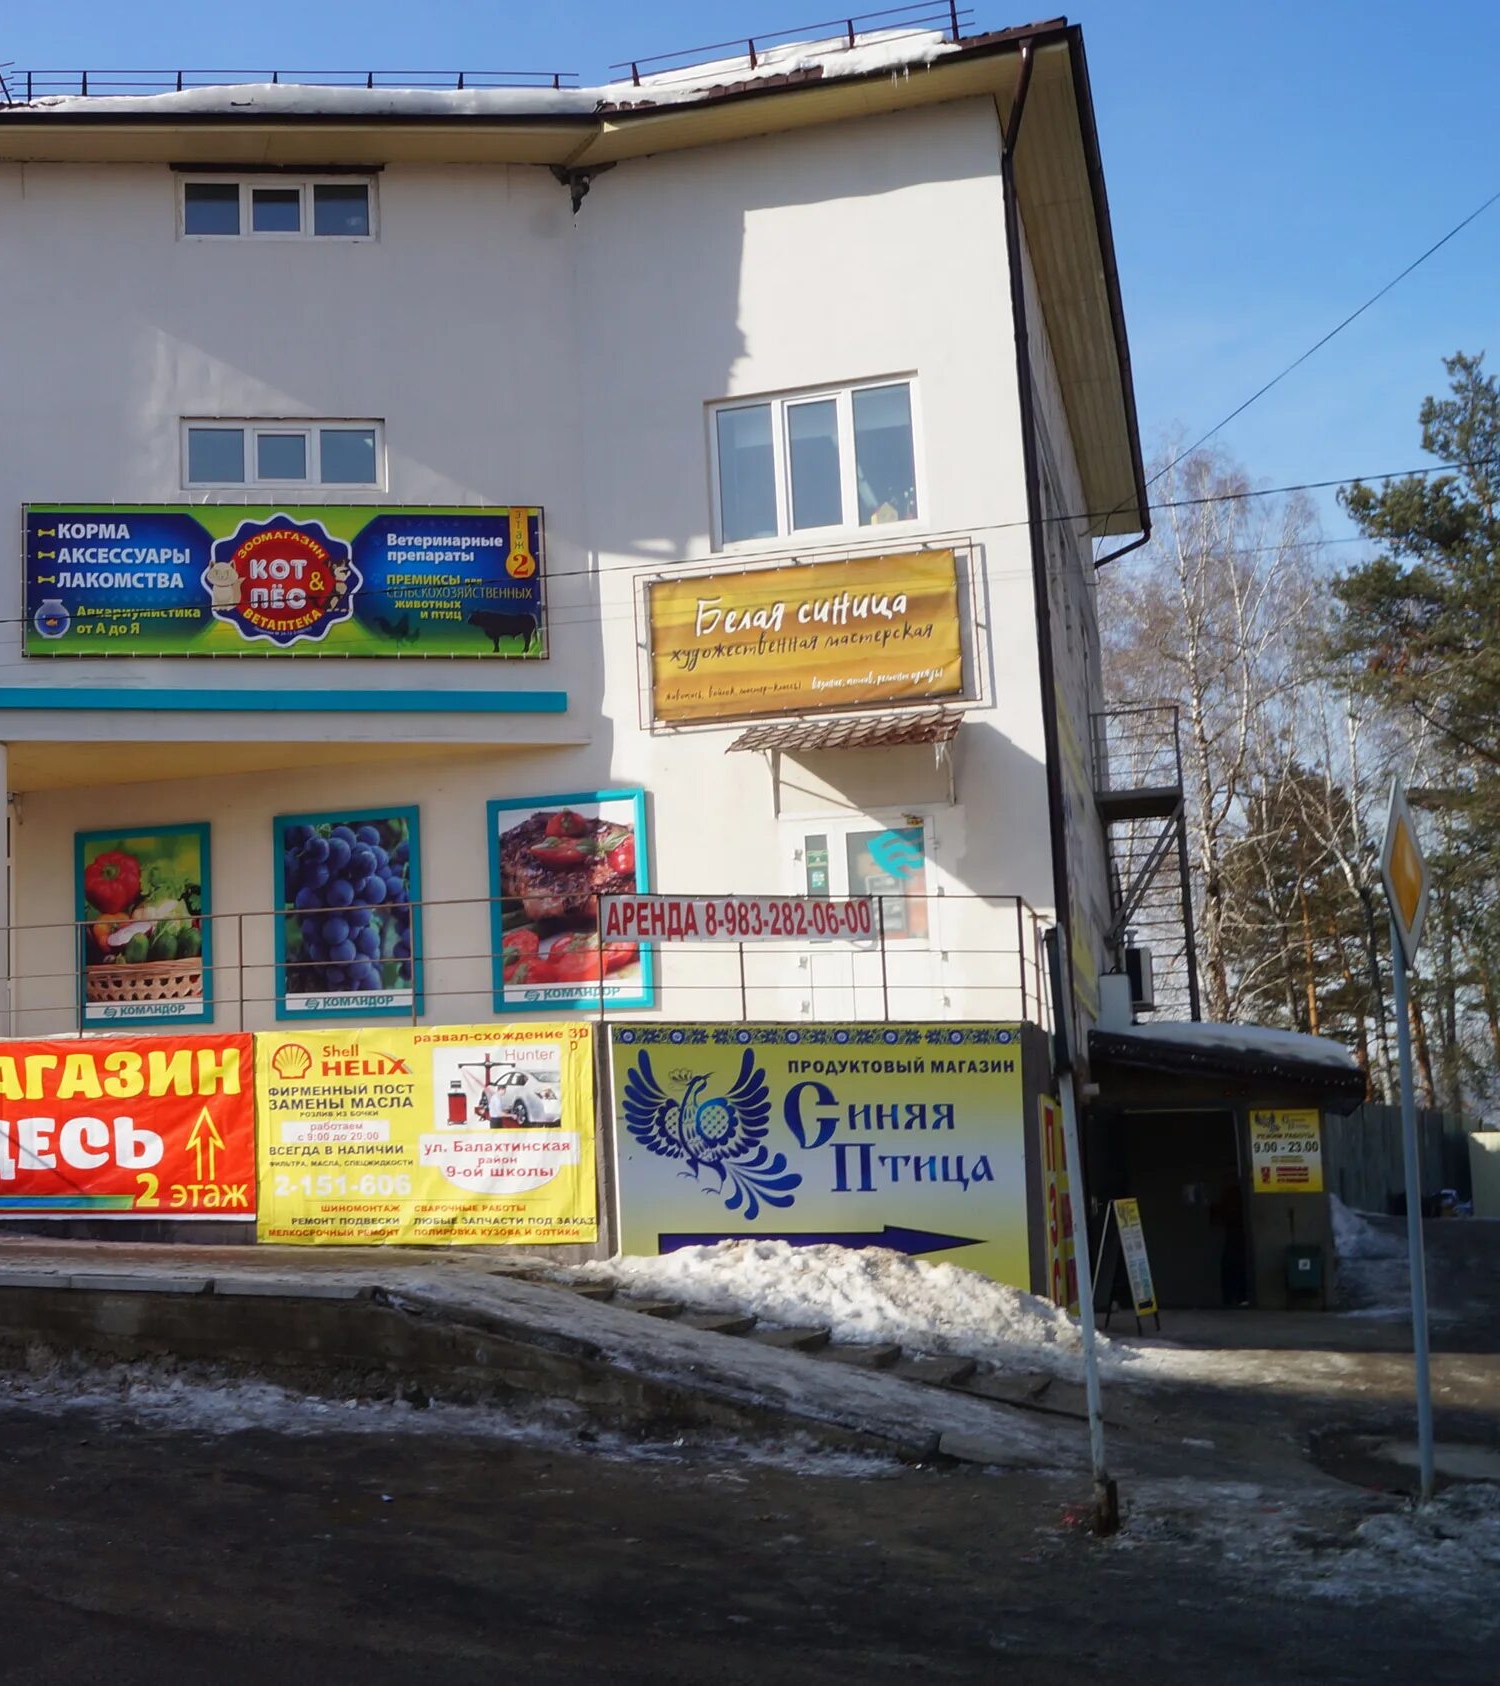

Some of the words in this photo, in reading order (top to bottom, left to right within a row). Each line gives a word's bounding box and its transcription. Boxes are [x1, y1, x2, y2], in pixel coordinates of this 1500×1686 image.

[57, 523, 131, 540] КОРМА
[238, 531, 326, 560] ЗООМАГАЗИН
[386, 533, 503, 549] Ветеринарные
[57, 548, 191, 565] АКСЕССУАРЫ
[387, 551, 475, 564] препараты
[250, 558, 308, 580] КОТ
[513, 554, 529, 576] 2
[56, 572, 184, 588] ЛАКОМСТВА
[386, 574, 461, 585] ПРЕМИКСЫ
[250, 584, 307, 609] ПЁС
[386, 585, 533, 599] СЕЛЬСКОХОЗЯЙСТВЕННЫХ
[242, 608, 323, 632] ВЕТАПТЕКА
[695, 596, 784, 637] Белая
[797, 591, 908, 626] синица
[76, 624, 93, 634] от
[95, 623, 107, 634] А
[109, 624, 128, 636] до
[130, 623, 140, 634] Я
[670, 634, 819, 671] художественная
[824, 622, 934, 649] мастерская
[605, 900, 699, 941] АРЕНДА
[704, 899, 871, 936] 8-983-282-06-00
[322, 995, 395, 1009] КОМАНДОР
[119, 1004, 186, 1016] КОМАНДОР
[413, 1031, 563, 1045] развал-схождение
[322, 1044, 359, 1057] Shell
[504, 1049, 555, 1061] Hunter
[322, 1058, 409, 1076] HELIX
[788, 1056, 925, 1076] ПРОДУКТОВЫЙ
[931, 1059, 1015, 1074] МАГАЗИН
[268, 1083, 368, 1097] ФИРМЕННЫЙ
[373, 1084, 415, 1095] ПОСТ
[269, 1098, 344, 1111] ЗАМЕНЫ
[350, 1097, 414, 1109] МАСЛА
[783, 1081, 955, 1149] Синяя
[310, 1121, 363, 1132] работаем
[333, 1134, 348, 1142] до
[269, 1146, 321, 1156] ВСЕГДА
[325, 1146, 333, 1155] В
[337, 1145, 404, 1155] НАЛИЧИИ
[424, 1143, 448, 1155] ул.
[453, 1141, 571, 1153] Балахтинская
[1253, 1141, 1278, 1153] 9.00
[1287, 1141, 1319, 1153] 23.00
[478, 1156, 518, 1167] район
[830, 1143, 996, 1193] Птица
[446, 1166, 483, 1178] 9-ой
[490, 1168, 554, 1177] школы
[135, 1173, 160, 1208] 2
[169, 1184, 249, 1209] этаж
[274, 1173, 412, 1197] 2-151-606
[321, 1205, 401, 1213] ШИНОМОНТАЖ
[414, 1204, 479, 1212] СВАРОЧНЫЕ
[482, 1204, 526, 1212] РАБОТЫ
[291, 1218, 335, 1226] РЕМОНТ
[339, 1217, 400, 1226] ПОДВЕСКИ
[413, 1217, 458, 1225] ЛЮБЫЕ
[461, 1217, 524, 1225] ЗАПЧАСТИ
[528, 1217, 554, 1226] ПОД
[358, 1229, 400, 1237] РЕМОНТ
[414, 1228, 478, 1236] ПОЛИРОВКА
[481, 1229, 521, 1237] КУЗОВА
